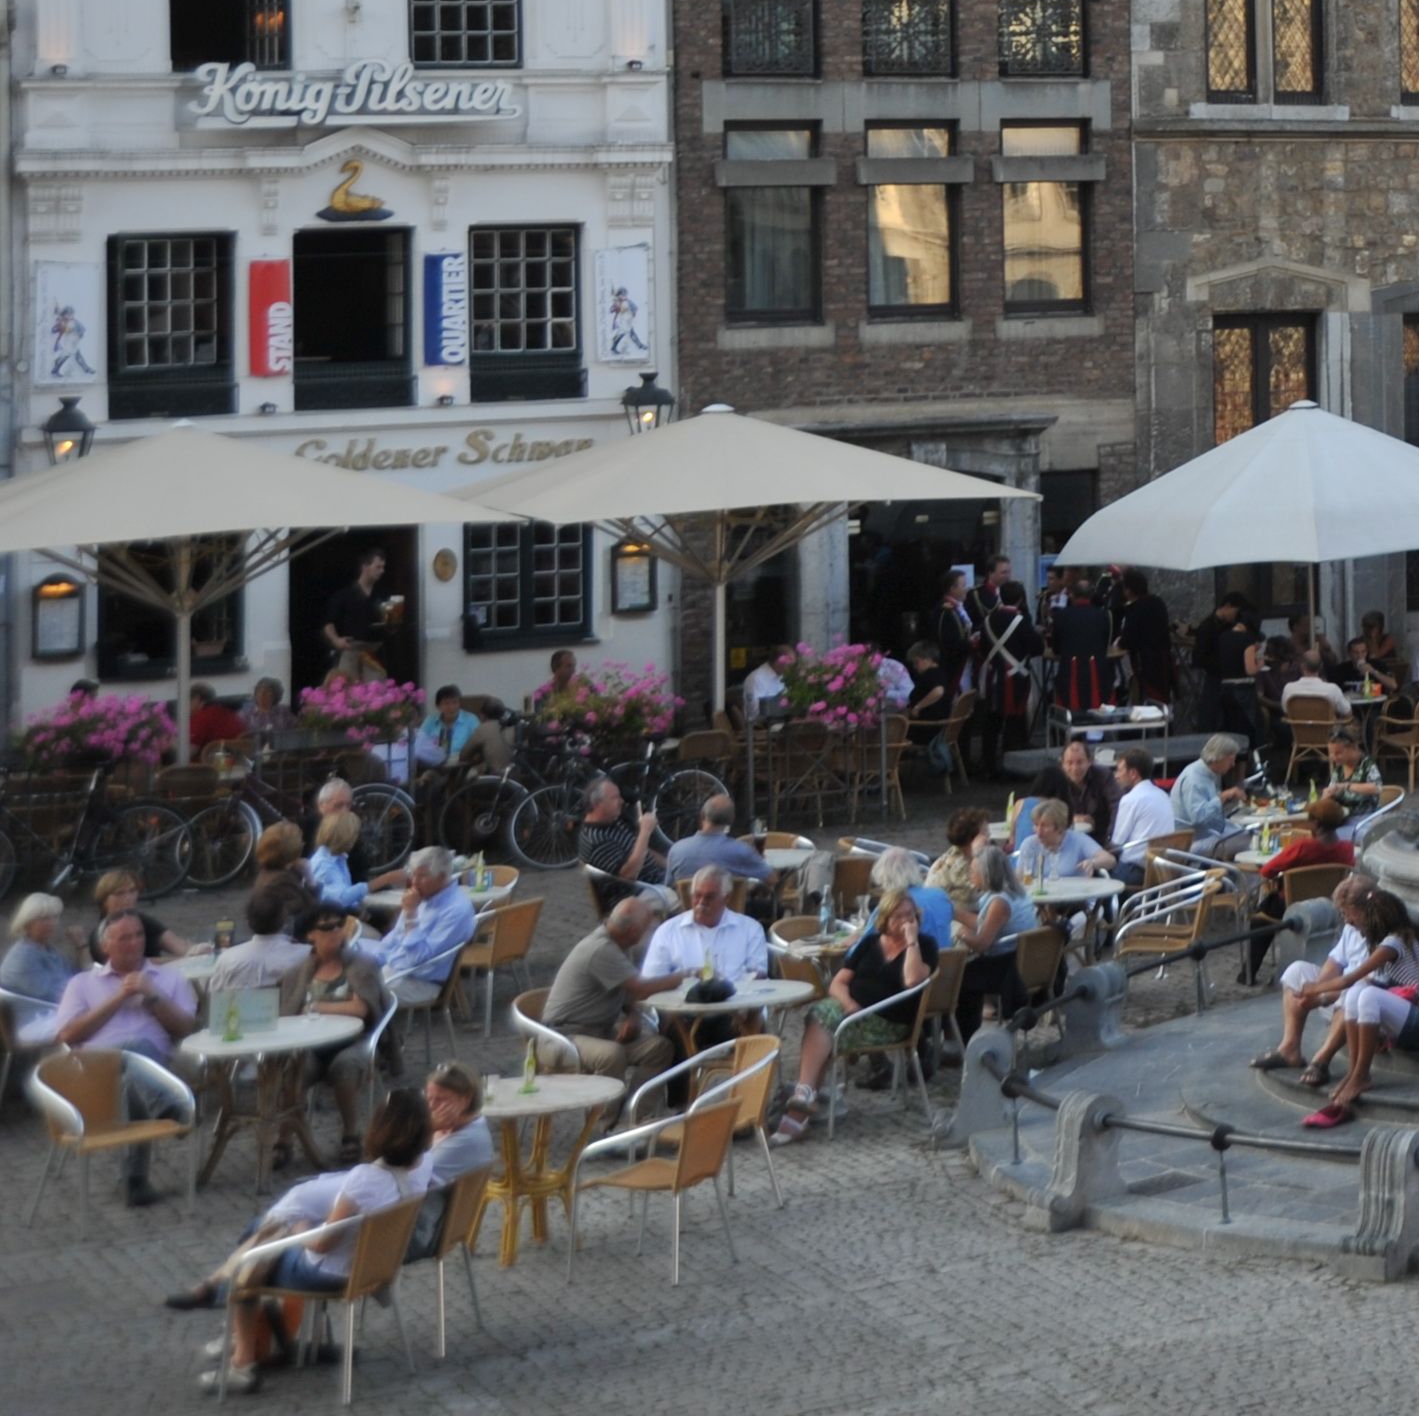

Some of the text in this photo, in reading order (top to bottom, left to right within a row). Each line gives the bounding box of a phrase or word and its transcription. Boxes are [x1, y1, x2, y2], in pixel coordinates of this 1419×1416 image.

[188, 58, 523, 125] König-Pilsener
[267, 300, 293, 373] STAND
[441, 255, 466, 364] QUARTIER
